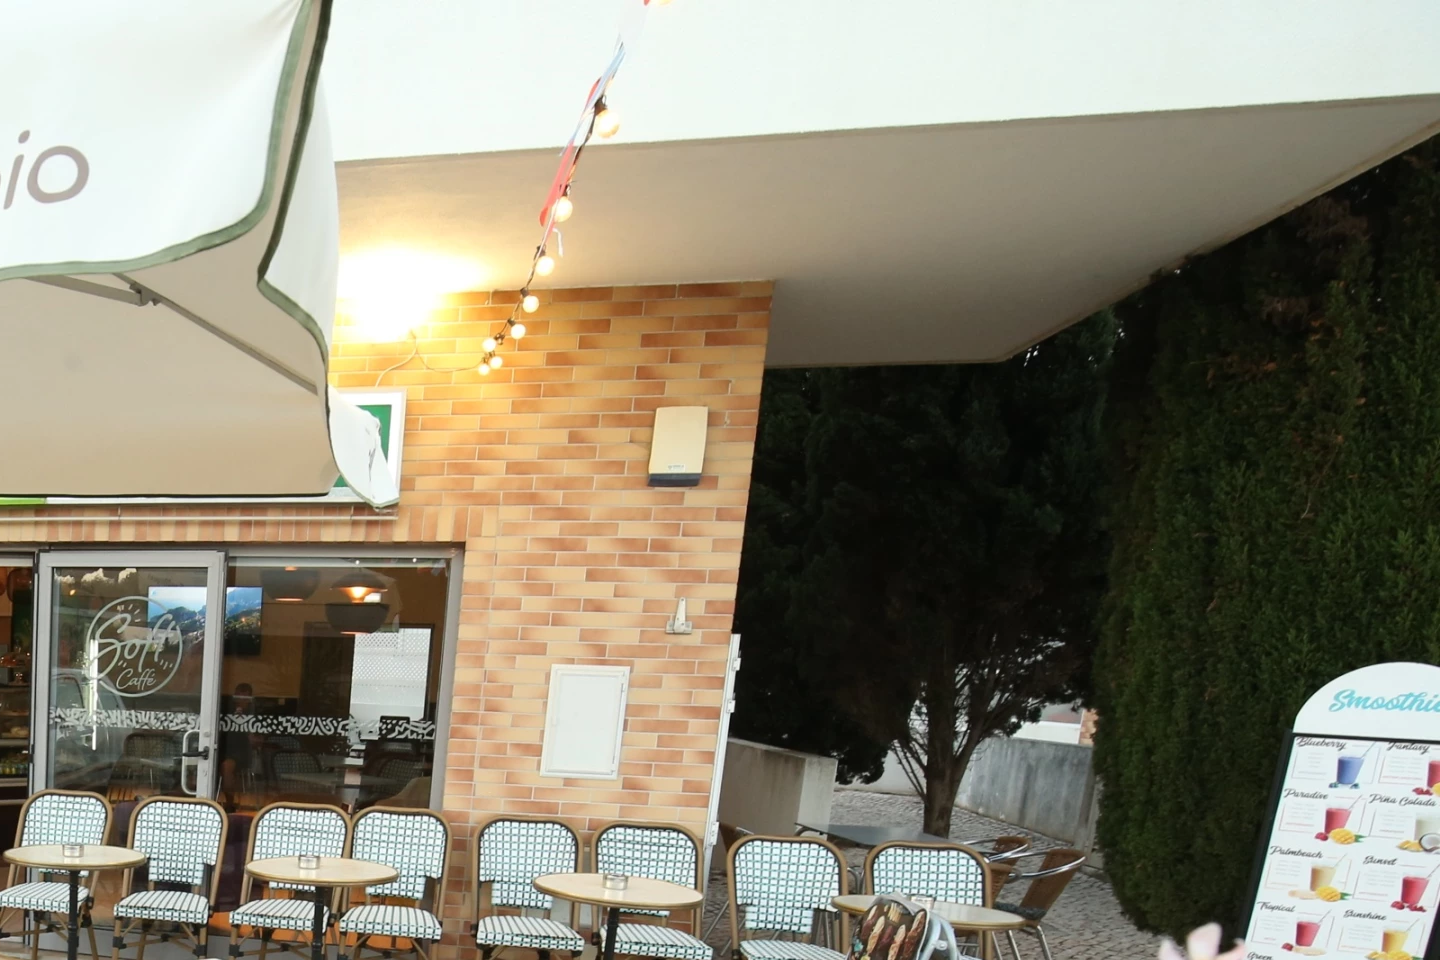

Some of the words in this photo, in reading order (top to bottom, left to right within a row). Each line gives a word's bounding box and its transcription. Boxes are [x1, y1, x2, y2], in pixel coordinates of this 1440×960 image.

[86, 613, 176, 681] Soft
[1296, 737, 1347, 751] Blueberry
[1284, 788, 1329, 800] Paradise
[1398, 796, 1437, 807] Colada
[1269, 845, 1324, 859] Palmbeach
[1362, 855, 1398, 866] Sunset
[1256, 901, 1297, 913] Tropical
[1343, 909, 1388, 921] Sunshine
